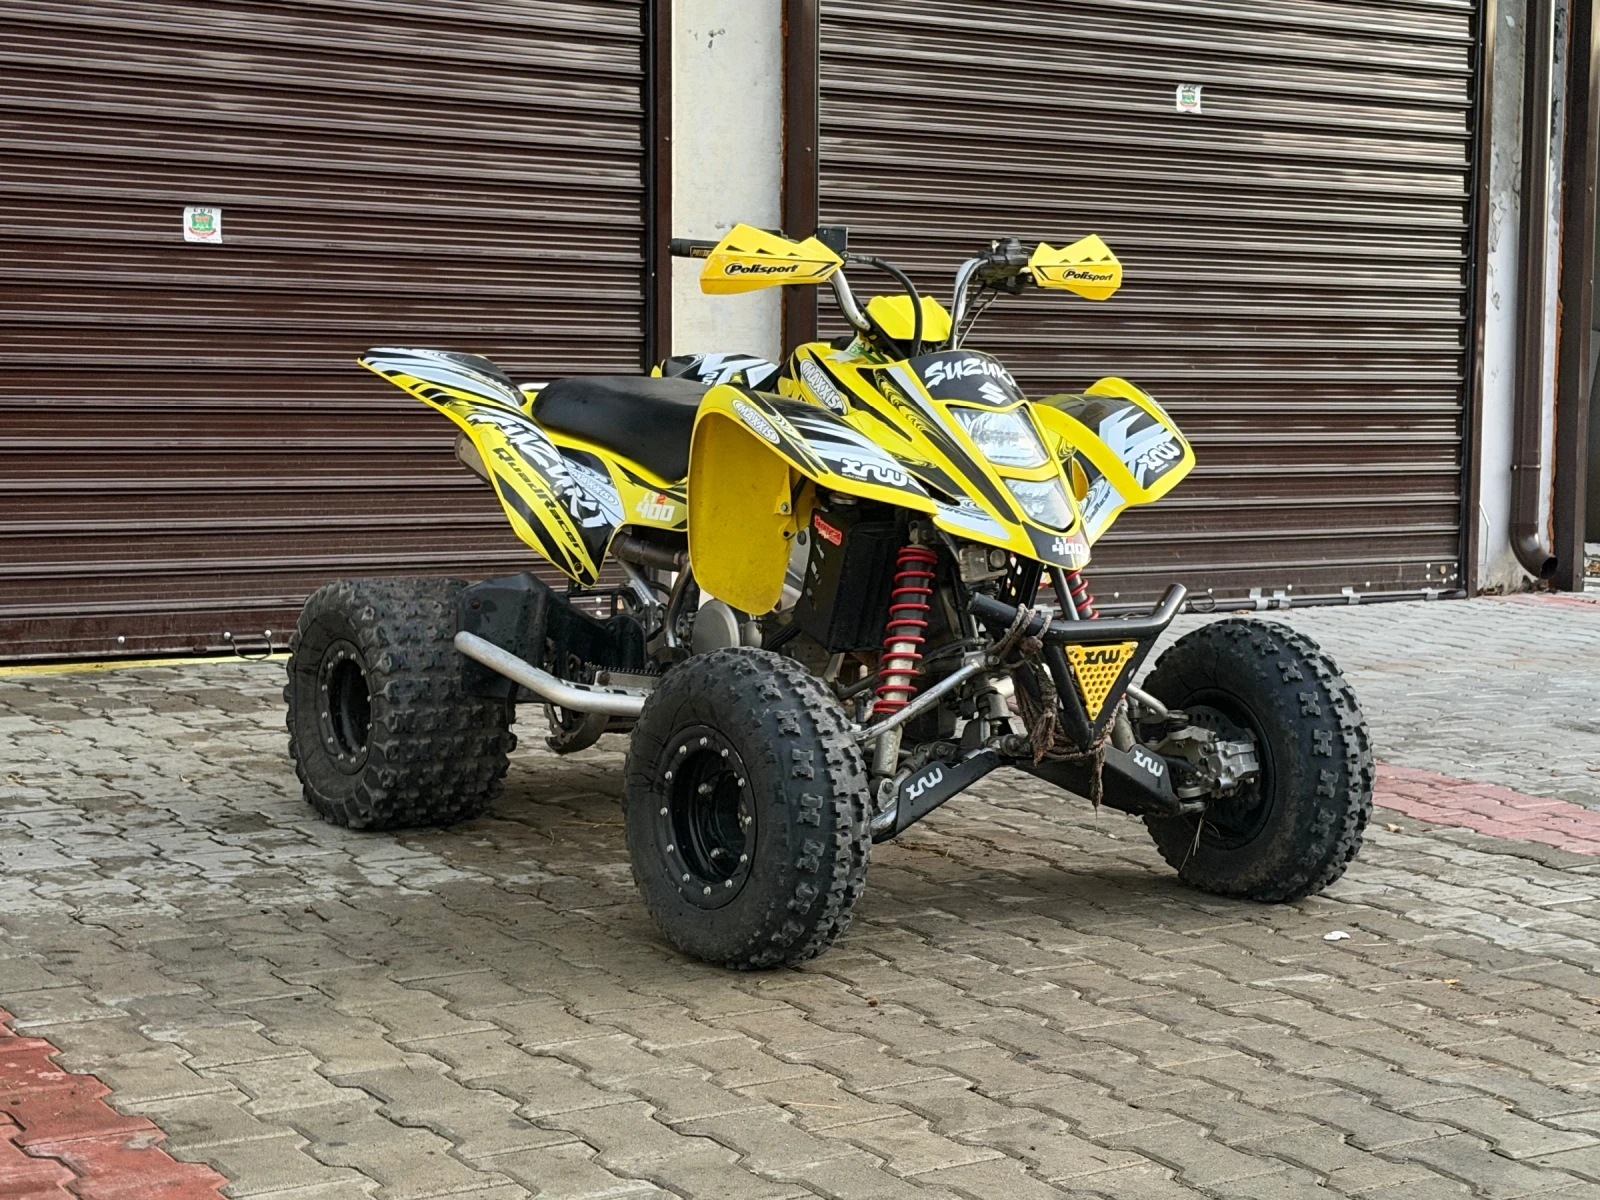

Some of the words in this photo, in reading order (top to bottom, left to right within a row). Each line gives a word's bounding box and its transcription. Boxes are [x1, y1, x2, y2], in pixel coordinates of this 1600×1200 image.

[725, 264, 799, 275] Polisport
[1063, 269, 1114, 281] Polisport
[804, 361, 842, 409] MAXXIS
[737, 403, 775, 438] MAXXIS
[571, 470, 612, 502] MAXXIS
[493, 447, 584, 555] QuadRacer
[635, 502, 675, 521] 400
[1052, 543, 1083, 556] 400
